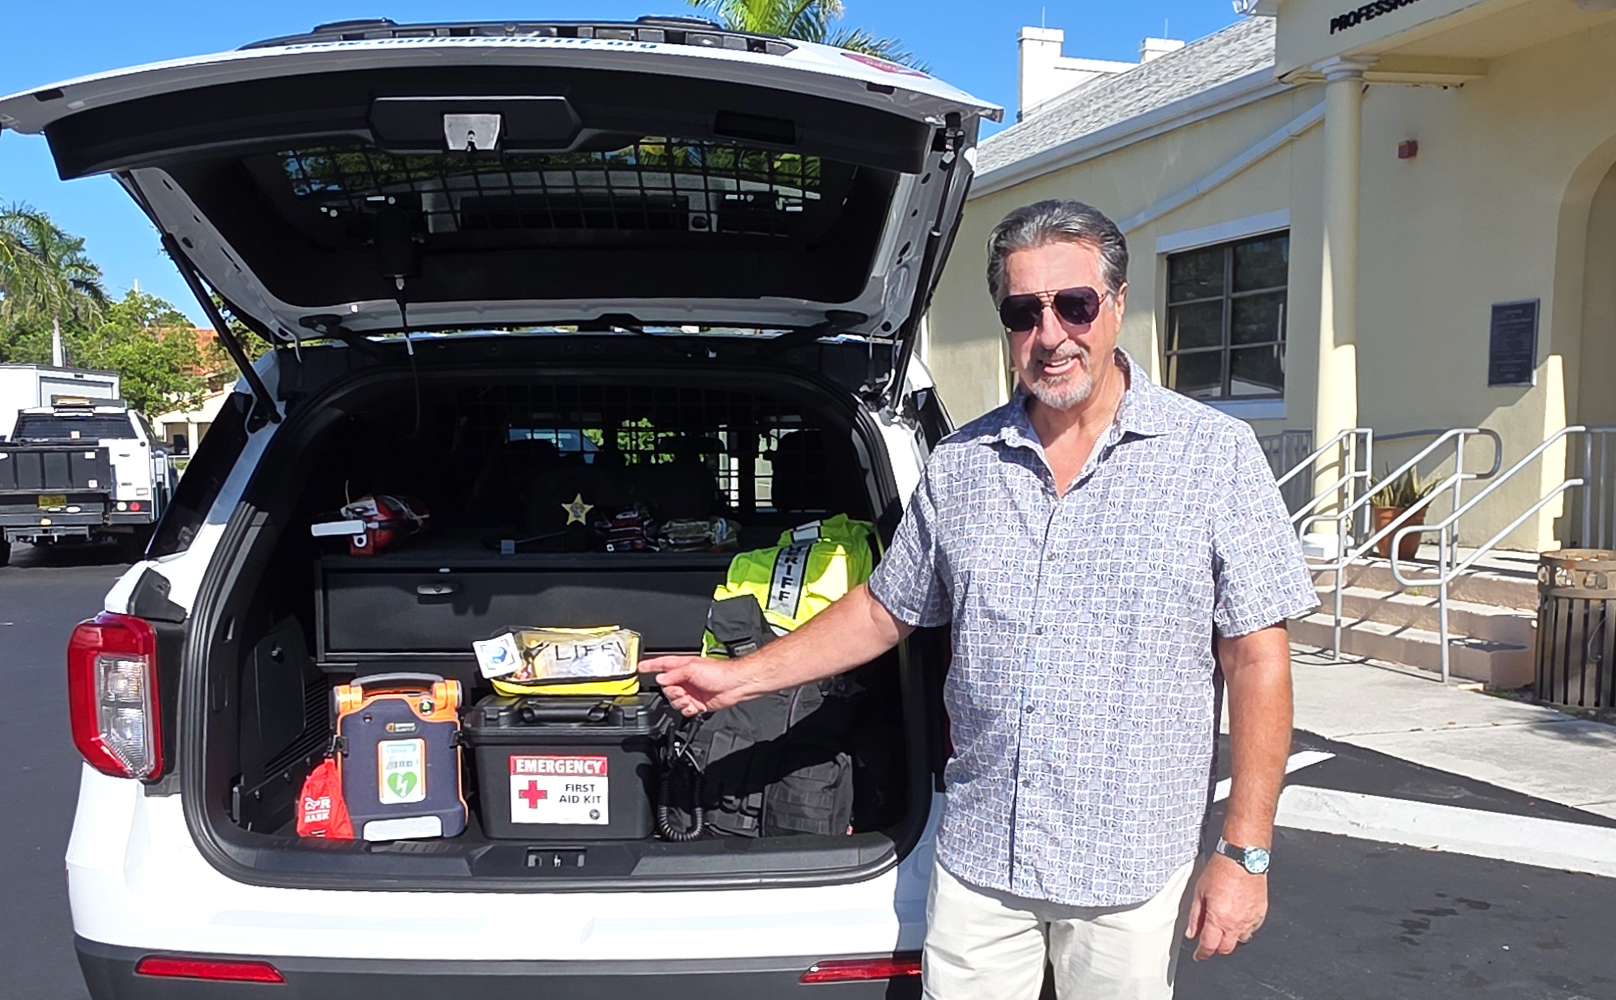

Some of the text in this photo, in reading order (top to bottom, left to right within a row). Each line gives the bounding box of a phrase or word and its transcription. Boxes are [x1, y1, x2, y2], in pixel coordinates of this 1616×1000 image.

[1329, 0, 1420, 35] PROFESSI
[516, 759, 603, 774] EMERGENCY
[565, 784, 595, 792] FIRST
[559, 795, 602, 804] AID KIT
